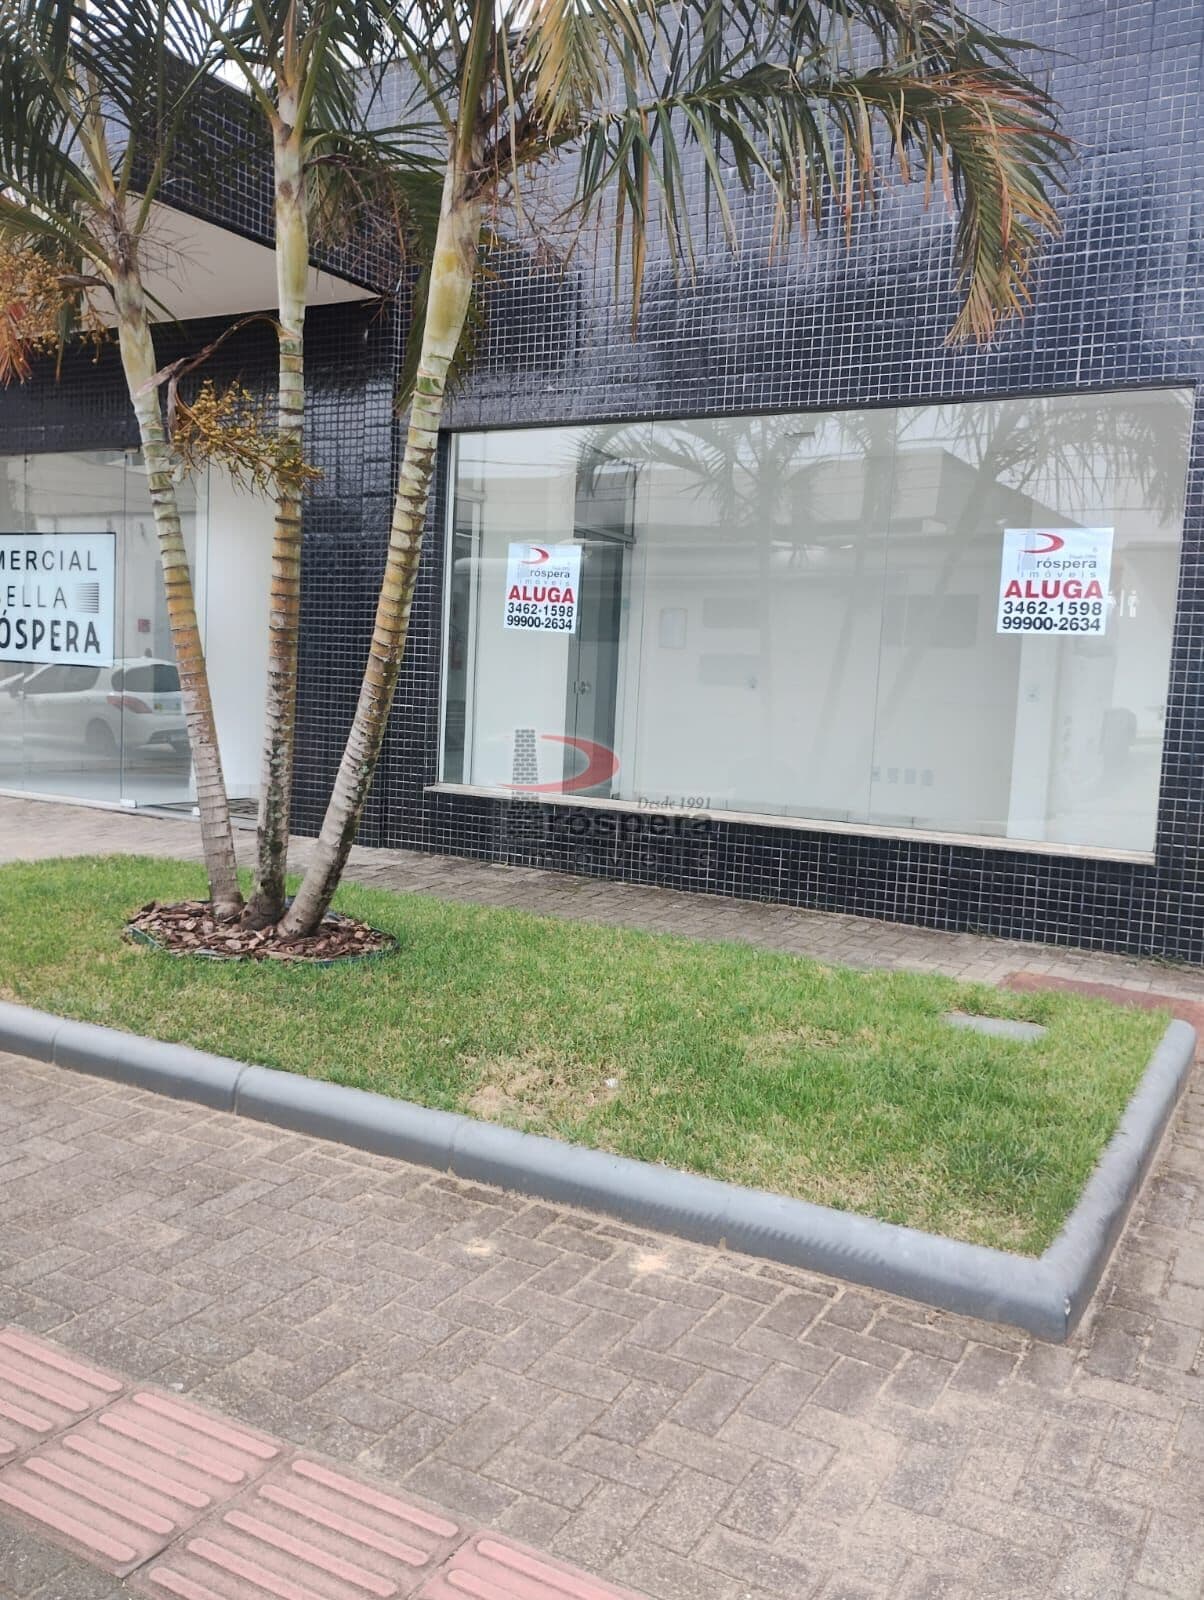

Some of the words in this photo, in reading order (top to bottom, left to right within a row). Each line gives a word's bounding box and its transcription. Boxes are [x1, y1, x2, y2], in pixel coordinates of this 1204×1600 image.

[1036, 557, 1097, 570] róspera
[530, 568, 570, 580] róspera
[508, 585, 574, 604] ALUGA
[1004, 579, 1103, 599] ALUGA
[0, 585, 67, 609] ELLA
[508, 602, 574, 617] 3462-1598
[1003, 601, 1102, 615] 3462-1598
[507, 615, 572, 631] 99900-2634
[1002, 616, 1101, 631] 99900-2634
